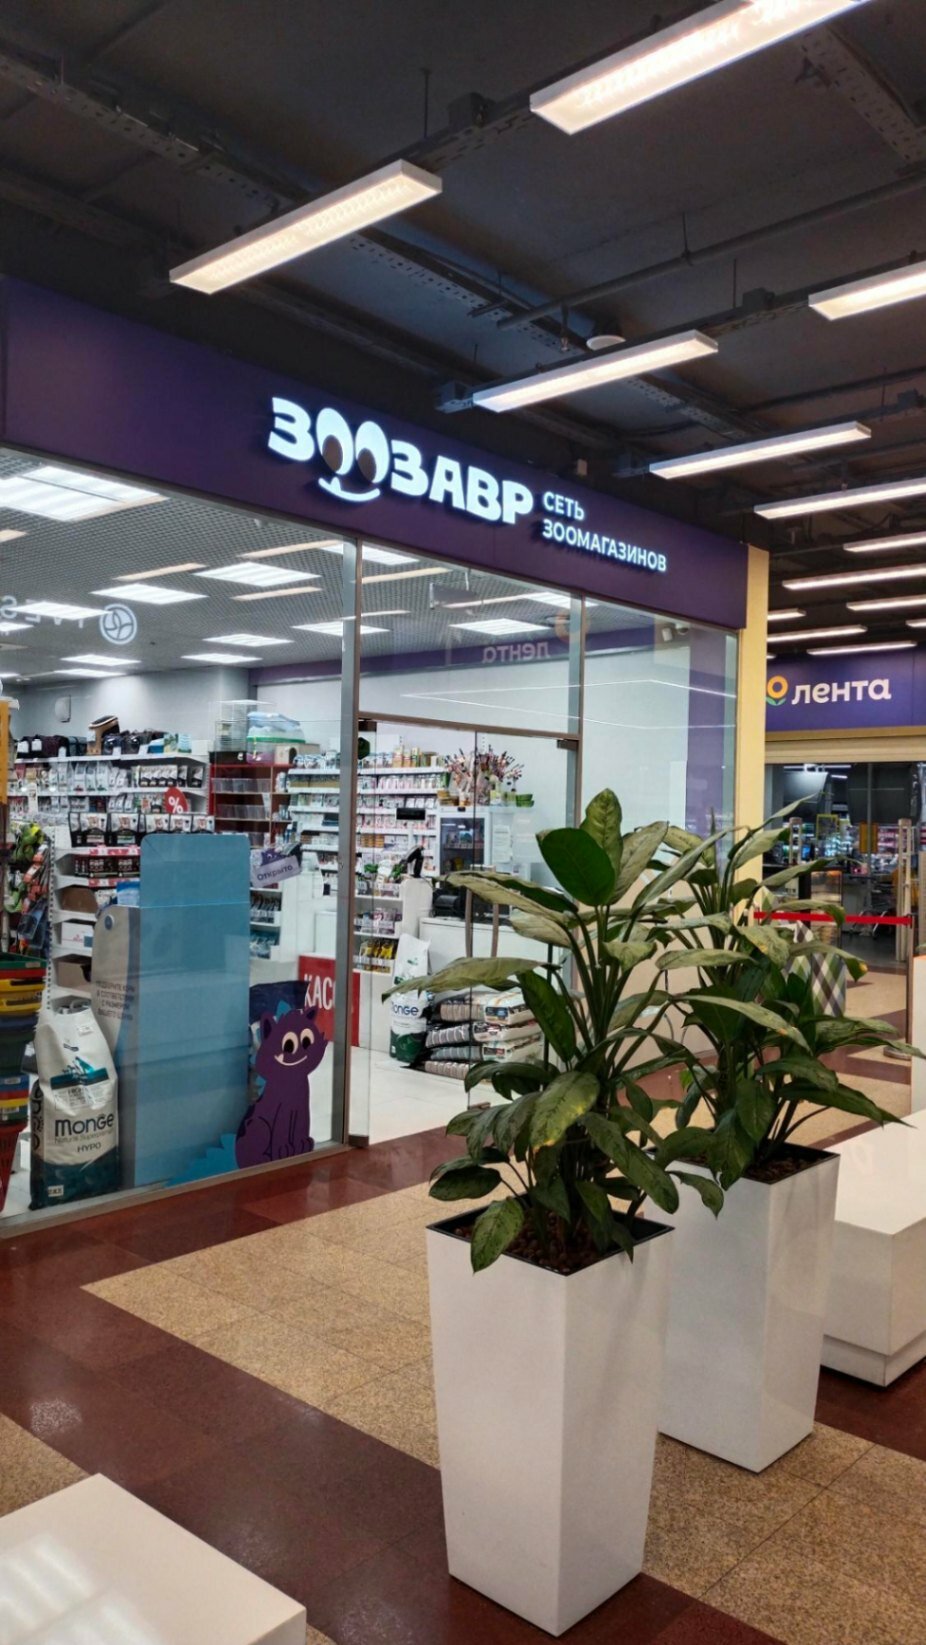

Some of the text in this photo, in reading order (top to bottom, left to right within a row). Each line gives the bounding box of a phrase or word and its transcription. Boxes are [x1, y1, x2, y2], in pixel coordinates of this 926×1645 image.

[268, 397, 534, 525] ЗООЗАВР
[543, 491, 585, 520] СЕТЬ
[542, 518, 667, 572] ЗООМАГАЗИНОВ
[791, 679, 892, 705] лента
[304, 973, 336, 1011] КАС
[77, 1141, 101, 1153] HYPO
